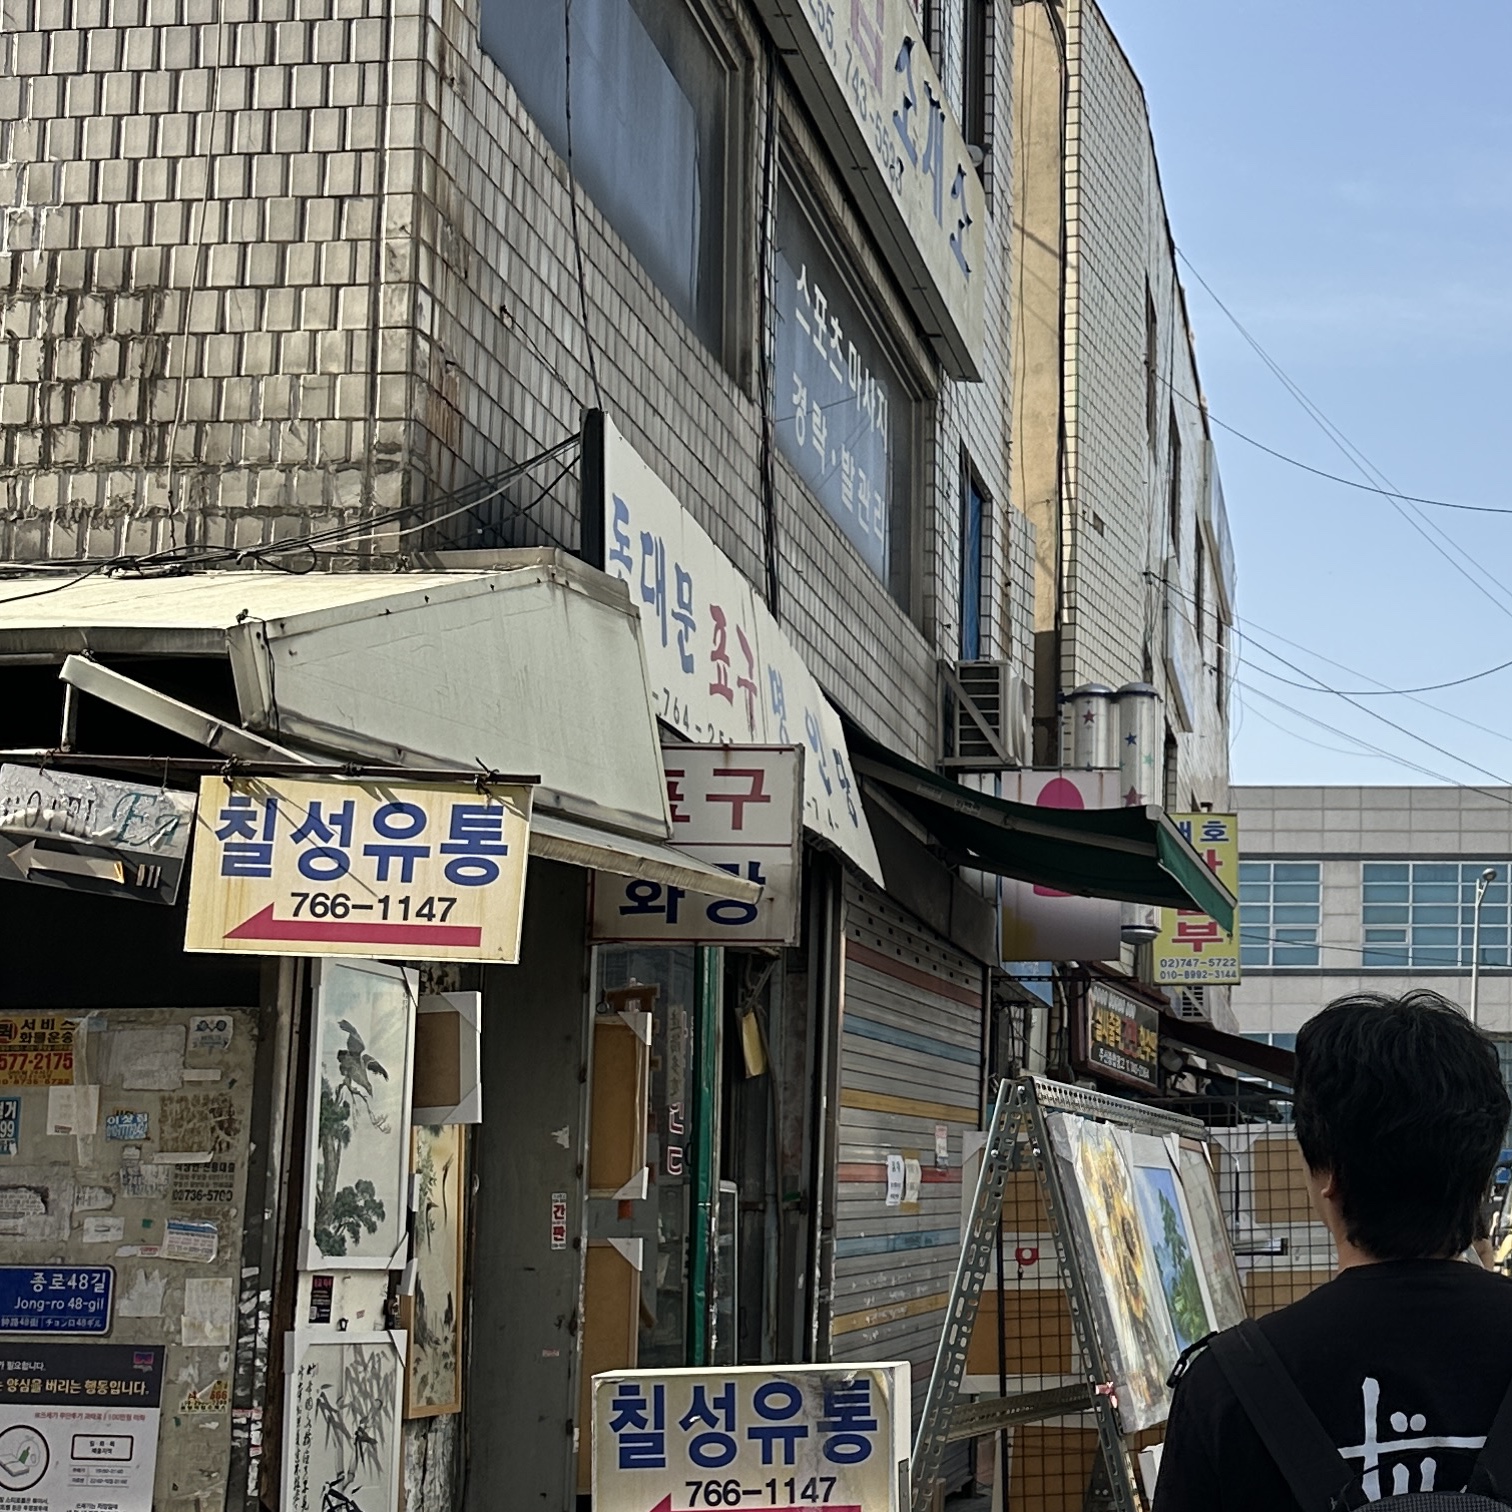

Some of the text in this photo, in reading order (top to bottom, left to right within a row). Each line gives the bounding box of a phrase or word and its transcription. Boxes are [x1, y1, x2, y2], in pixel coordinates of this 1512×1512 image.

[214, 796, 510, 888] 칠성유통
[290, 891, 458, 923] 766-1147
[1159, 958, 1237, 969] 02)747-5722
[20, 1018, 77, 1031] 서비스
[30, 1271, 106, 1293] 종로48길
[14, 1297, 104, 1312] Jong-ro 48-gil
[7, 1378, 150, 1395] 양심을 버리는 행동입니다.
[608, 1380, 879, 1471] 칠성유통
[684, 1476, 838, 1507] 766-1147
